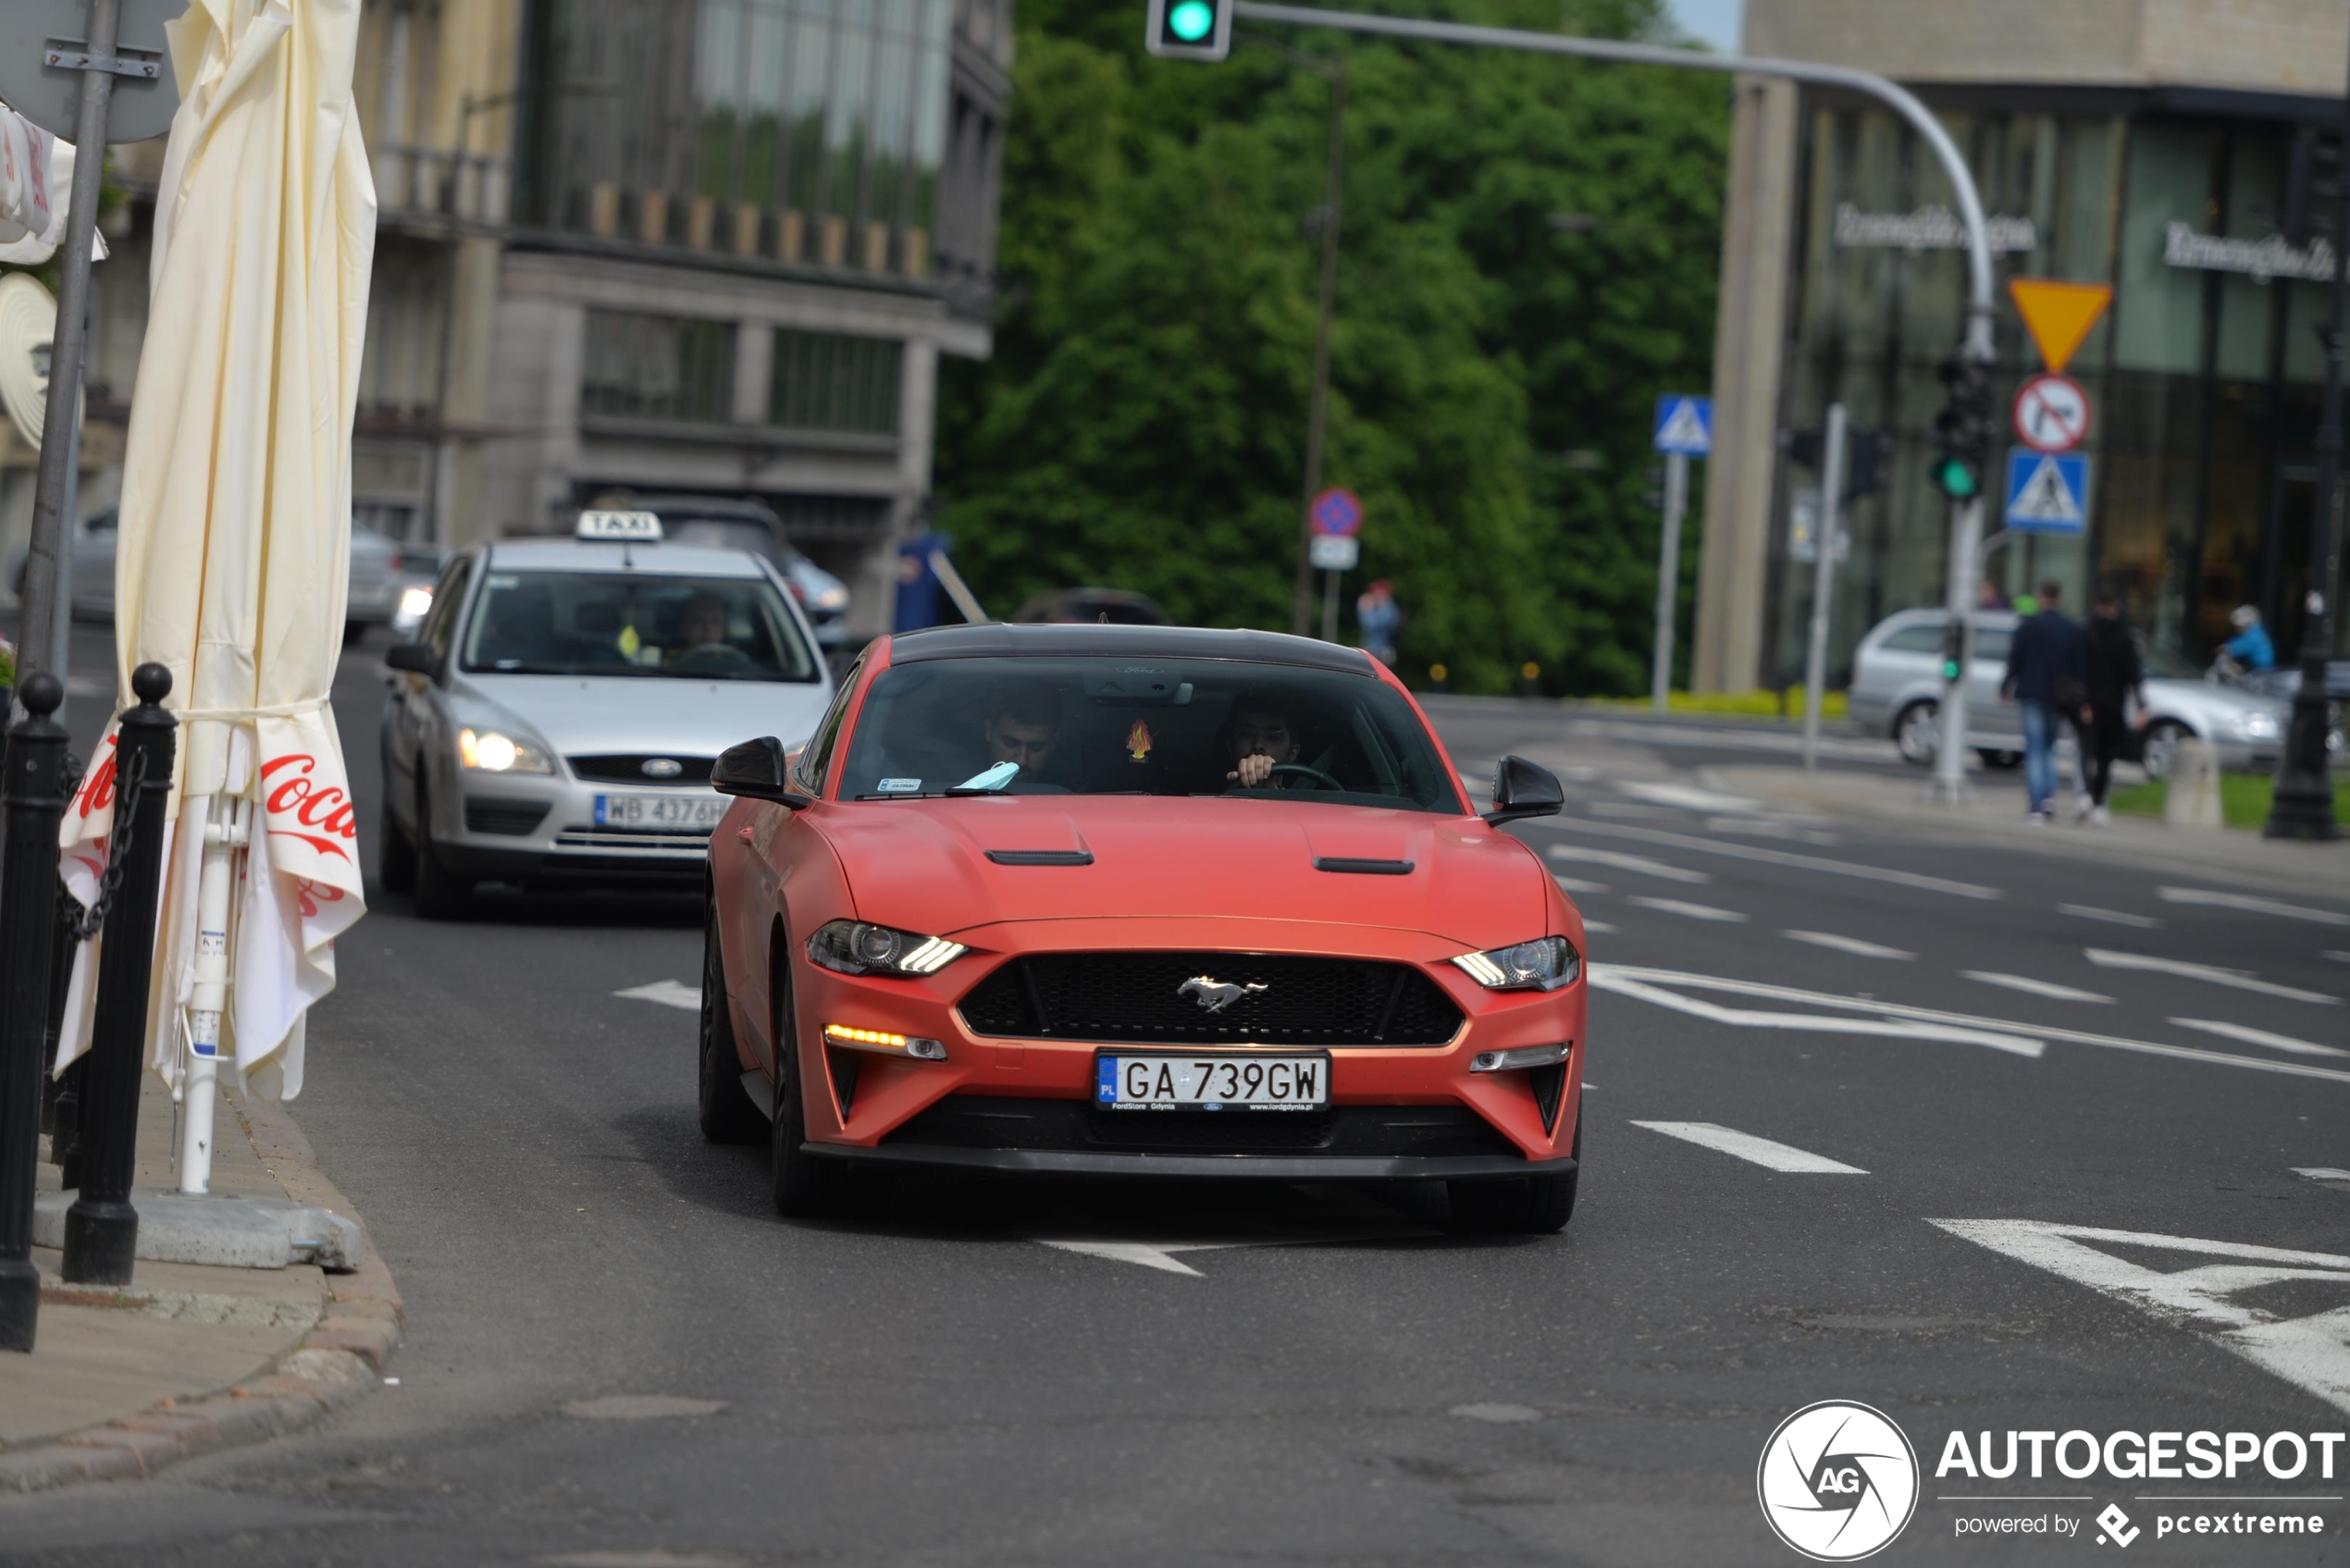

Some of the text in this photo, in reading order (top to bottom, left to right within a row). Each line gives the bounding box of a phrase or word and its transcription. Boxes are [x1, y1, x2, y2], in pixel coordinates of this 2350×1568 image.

[590, 513, 651, 529] TAXI
[609, 797, 642, 821] WB
[1101, 1084, 1115, 1095] PL
[1127, 1062, 1316, 1099] GA 739GW
